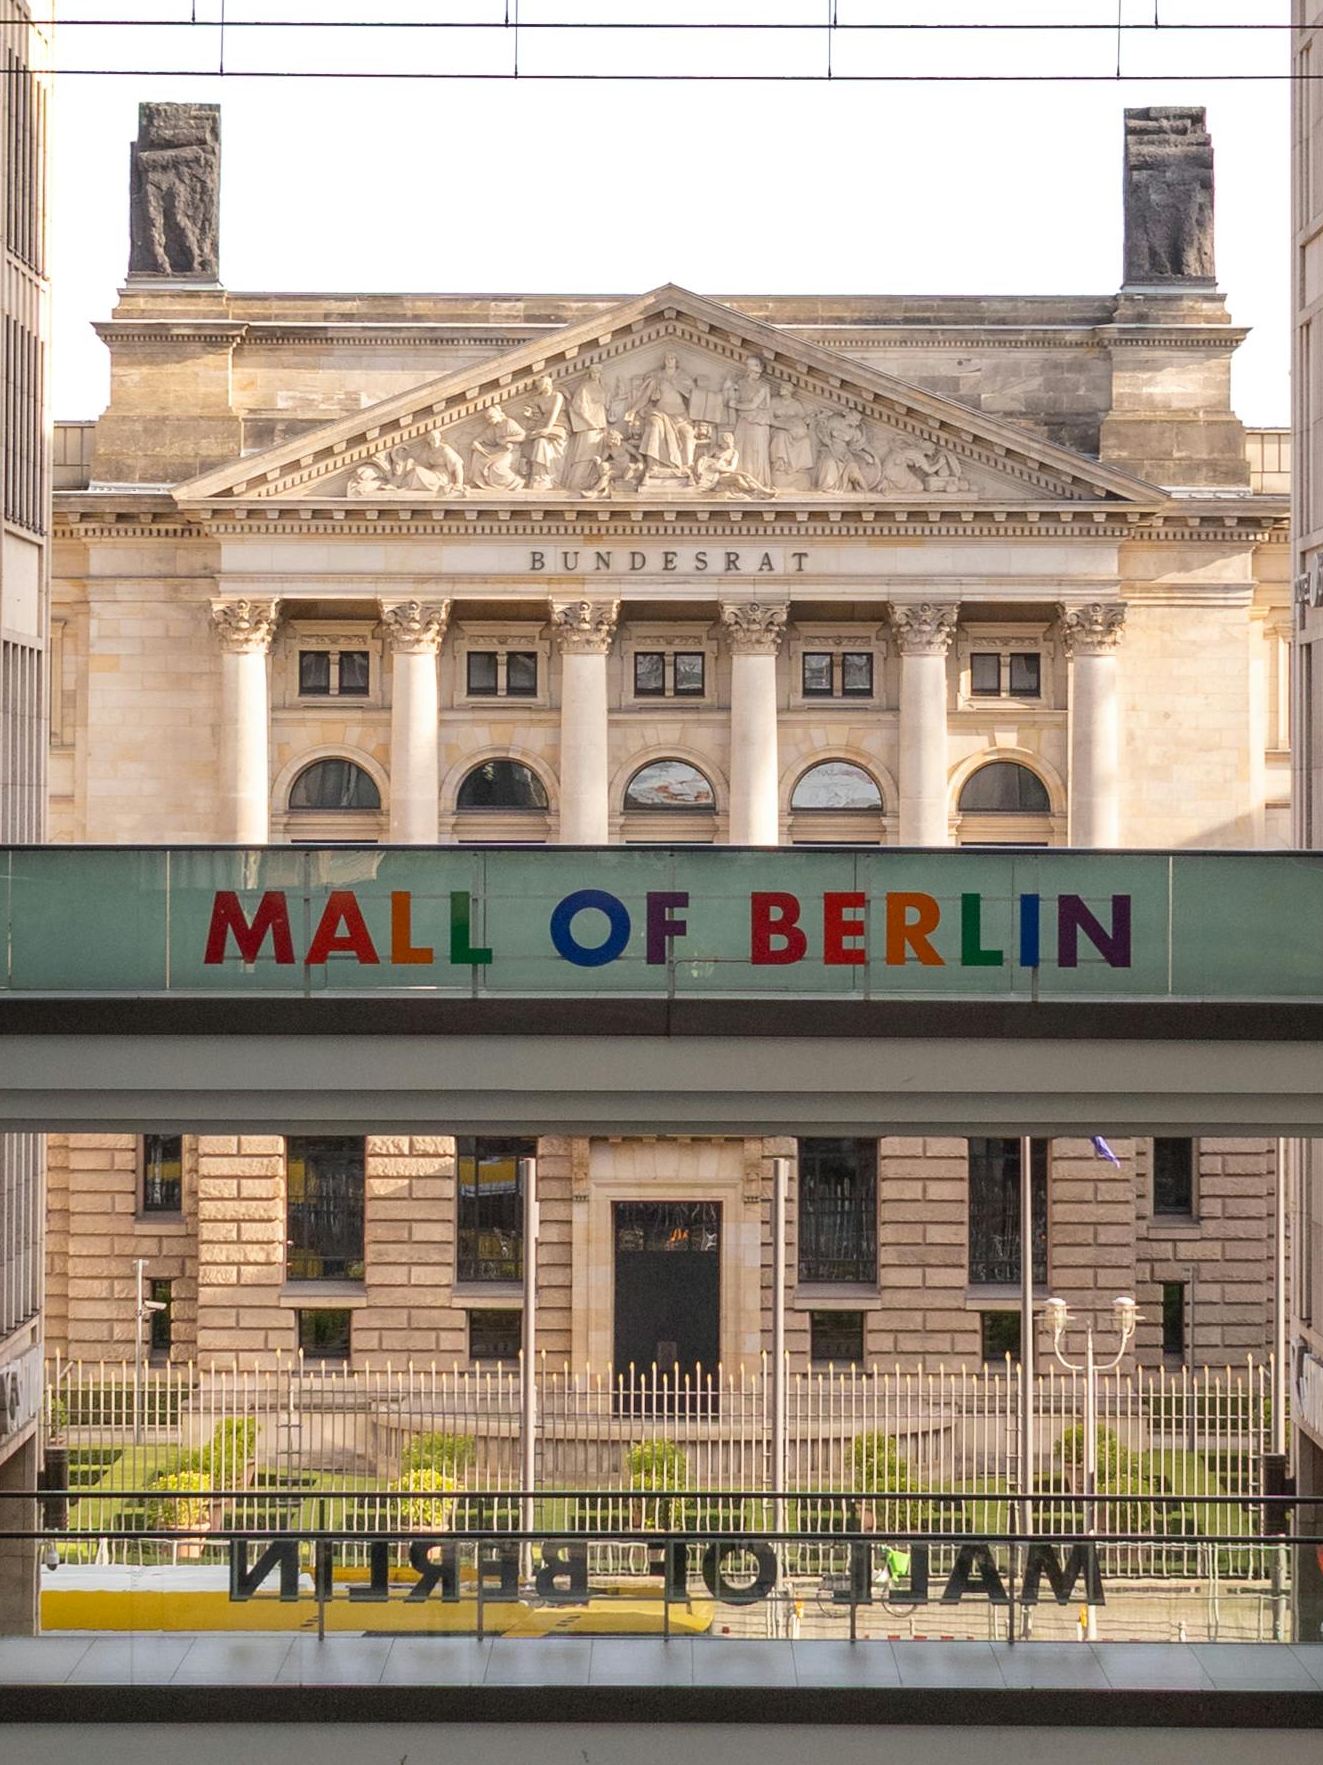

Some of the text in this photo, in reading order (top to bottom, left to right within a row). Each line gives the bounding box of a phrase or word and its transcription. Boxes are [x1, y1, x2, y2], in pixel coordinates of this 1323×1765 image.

[529, 549, 811, 574] BUNDESRAT
[204, 888, 1132, 969] MALL OF BERLIN
